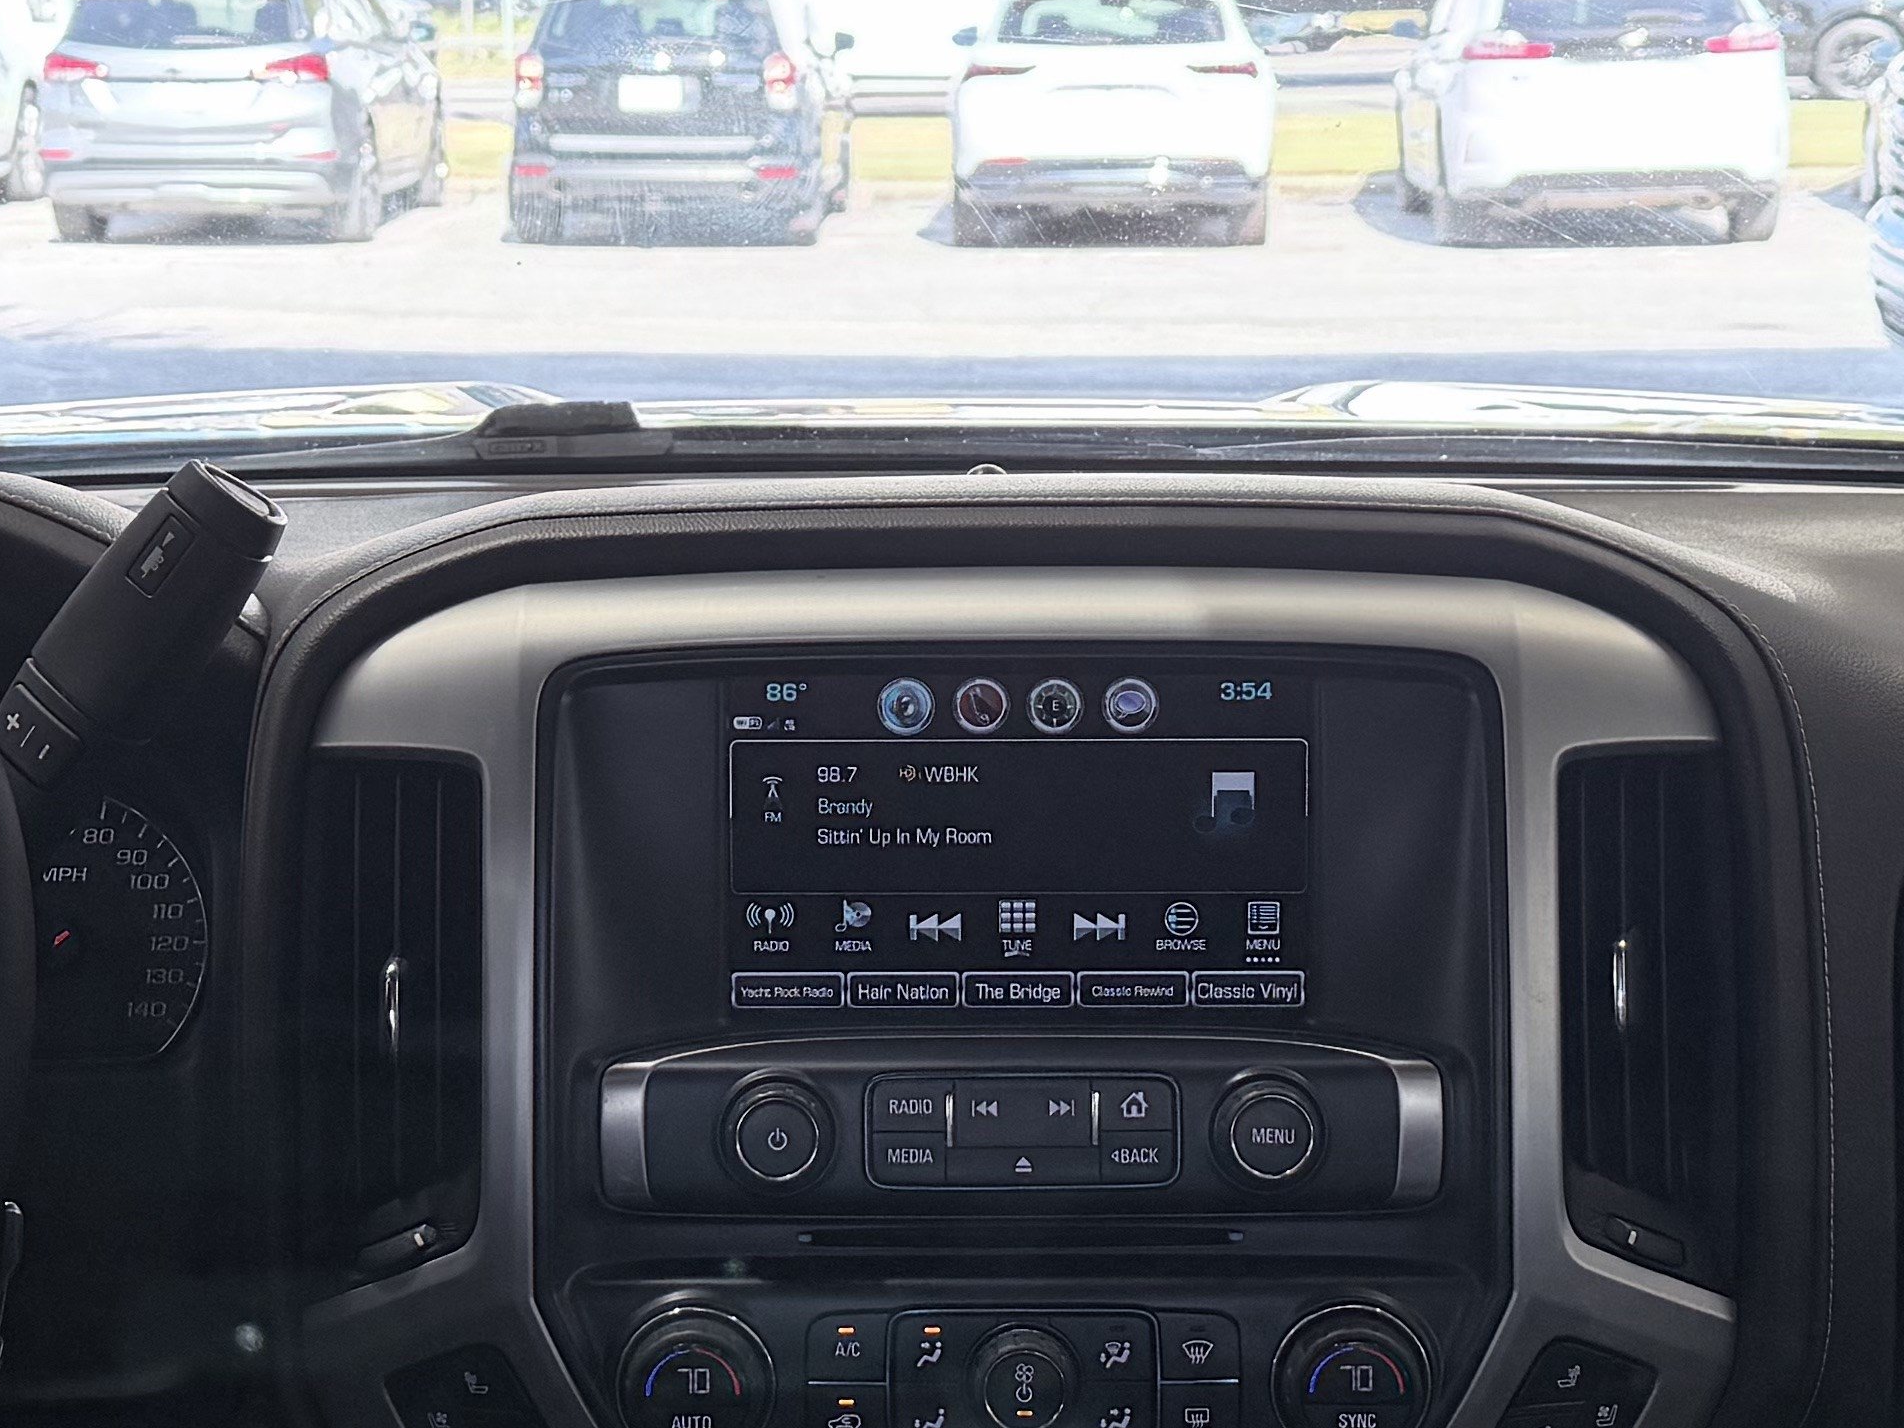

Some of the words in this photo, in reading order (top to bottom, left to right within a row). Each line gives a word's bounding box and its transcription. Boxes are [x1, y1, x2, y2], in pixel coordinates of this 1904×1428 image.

[766, 682, 808, 702] 86°
[1220, 682, 1272, 701] 3:54
[817, 766, 858, 783] 98.7
[924, 766, 979, 783] WBHK
[818, 798, 873, 818] Brandy
[764, 811, 782, 823] FM
[82, 827, 115, 845] 80
[817, 828, 863, 845] Sittin'
[869, 828, 891, 848] Up
[896, 828, 911, 845] In
[916, 828, 940, 848] My
[945, 828, 992, 845] Room
[116, 849, 148, 866] 90
[130, 873, 170, 890] 100
[152, 903, 184, 920] 110
[150, 935, 189, 952] 120
[753, 940, 790, 952] RADIO
[835, 940, 872, 952] MEDIA
[1001, 940, 1032, 952] TUNE
[1155, 939, 1207, 951] BROWSE
[1245, 939, 1281, 951] MENU
[145, 968, 184, 985] 130
[802, 986, 834, 998] Radio
[858, 983, 892, 1000] Hair
[896, 983, 949, 1001] Nation
[974, 983, 1004, 1000] The
[1009, 982, 1061, 1003] Bridge
[1091, 985, 1132, 998] Classic
[1197, 982, 1255, 999] Classic
[1259, 982, 1298, 1003] Vinyl
[128, 1001, 167, 1018] 140
[888, 1098, 934, 1115] RADIO
[1250, 1127, 1296, 1145] MENU
[887, 1148, 934, 1164] MEDIA
[1120, 1147, 1159, 1164] BACK
[834, 1341, 861, 1359] A/C
[677, 1368, 711, 1395] 70
[1339, 1365, 1373, 1393] 70
